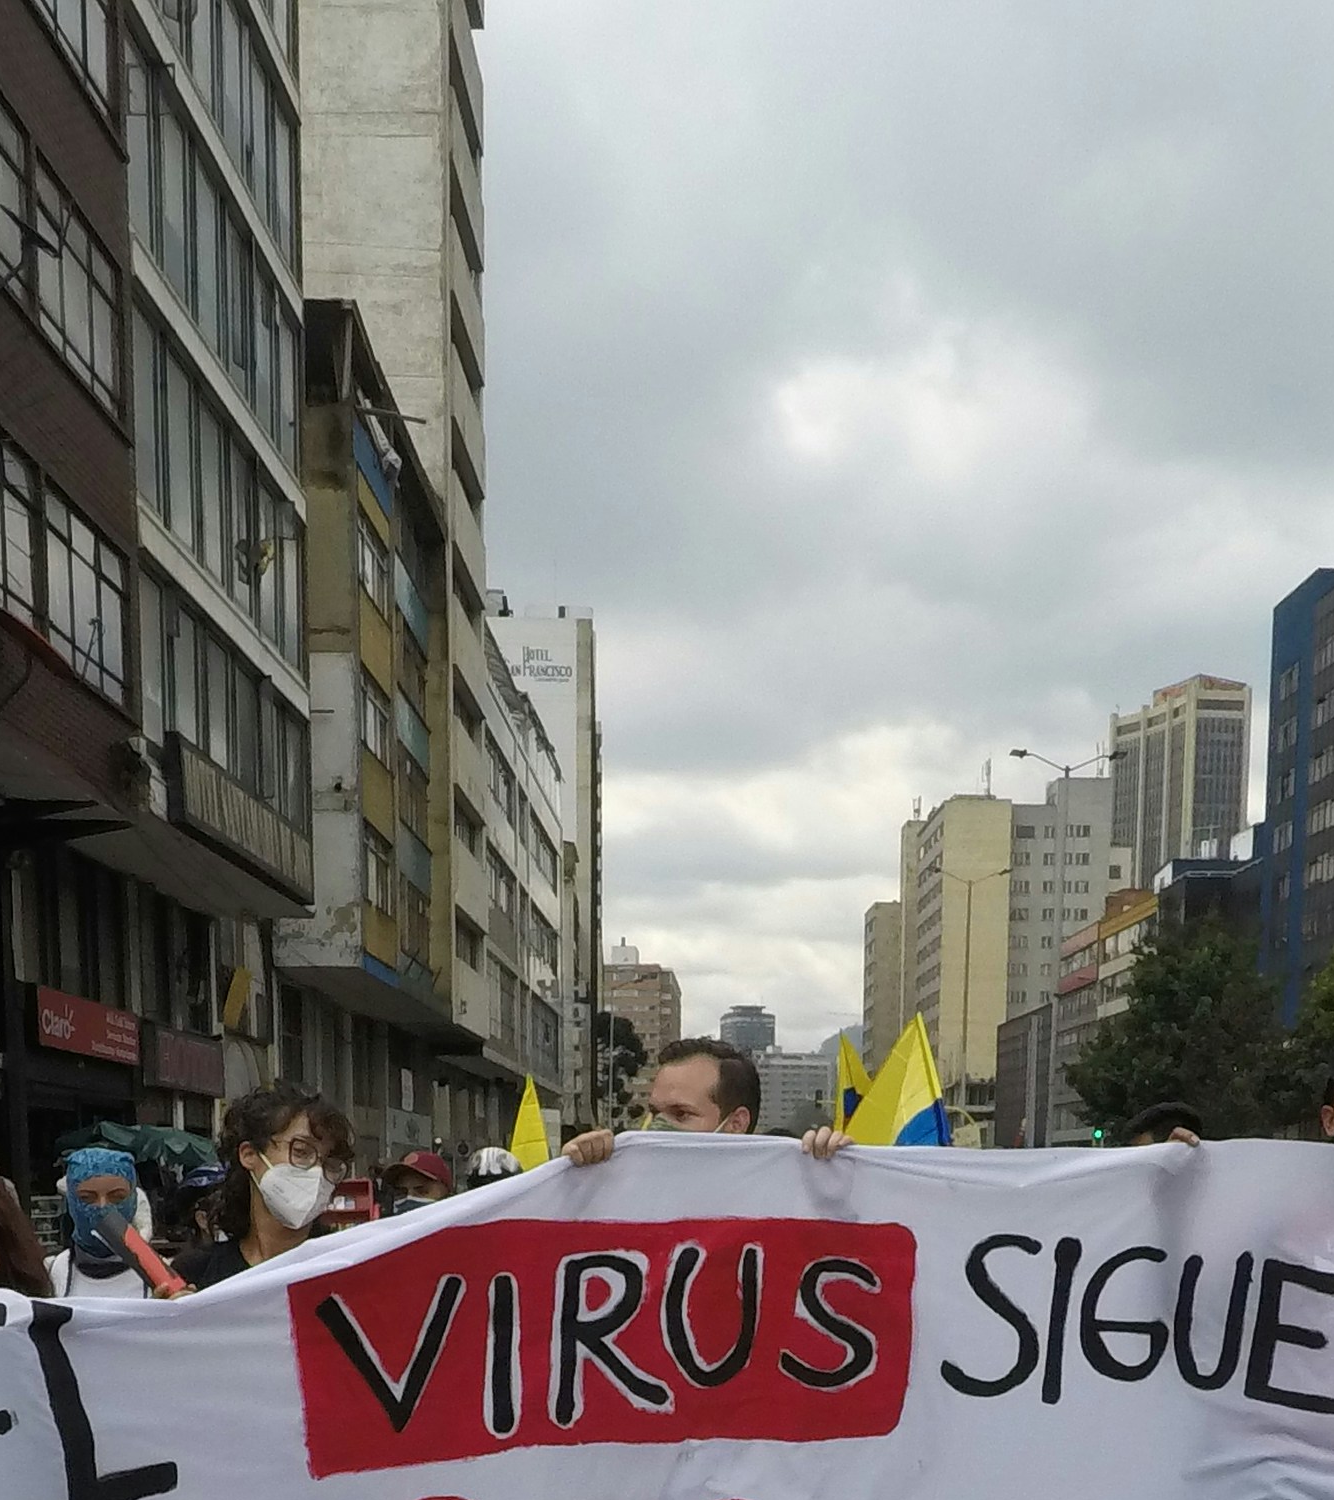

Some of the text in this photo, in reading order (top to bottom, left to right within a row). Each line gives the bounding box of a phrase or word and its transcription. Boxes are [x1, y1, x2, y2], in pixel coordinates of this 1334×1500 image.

[522, 646, 553, 663] HOTEL
[523, 662, 573, 677] FRANCISCO
[41, 1008, 72, 1040] Claro
[312, 1243, 882, 1437] VIRUS
